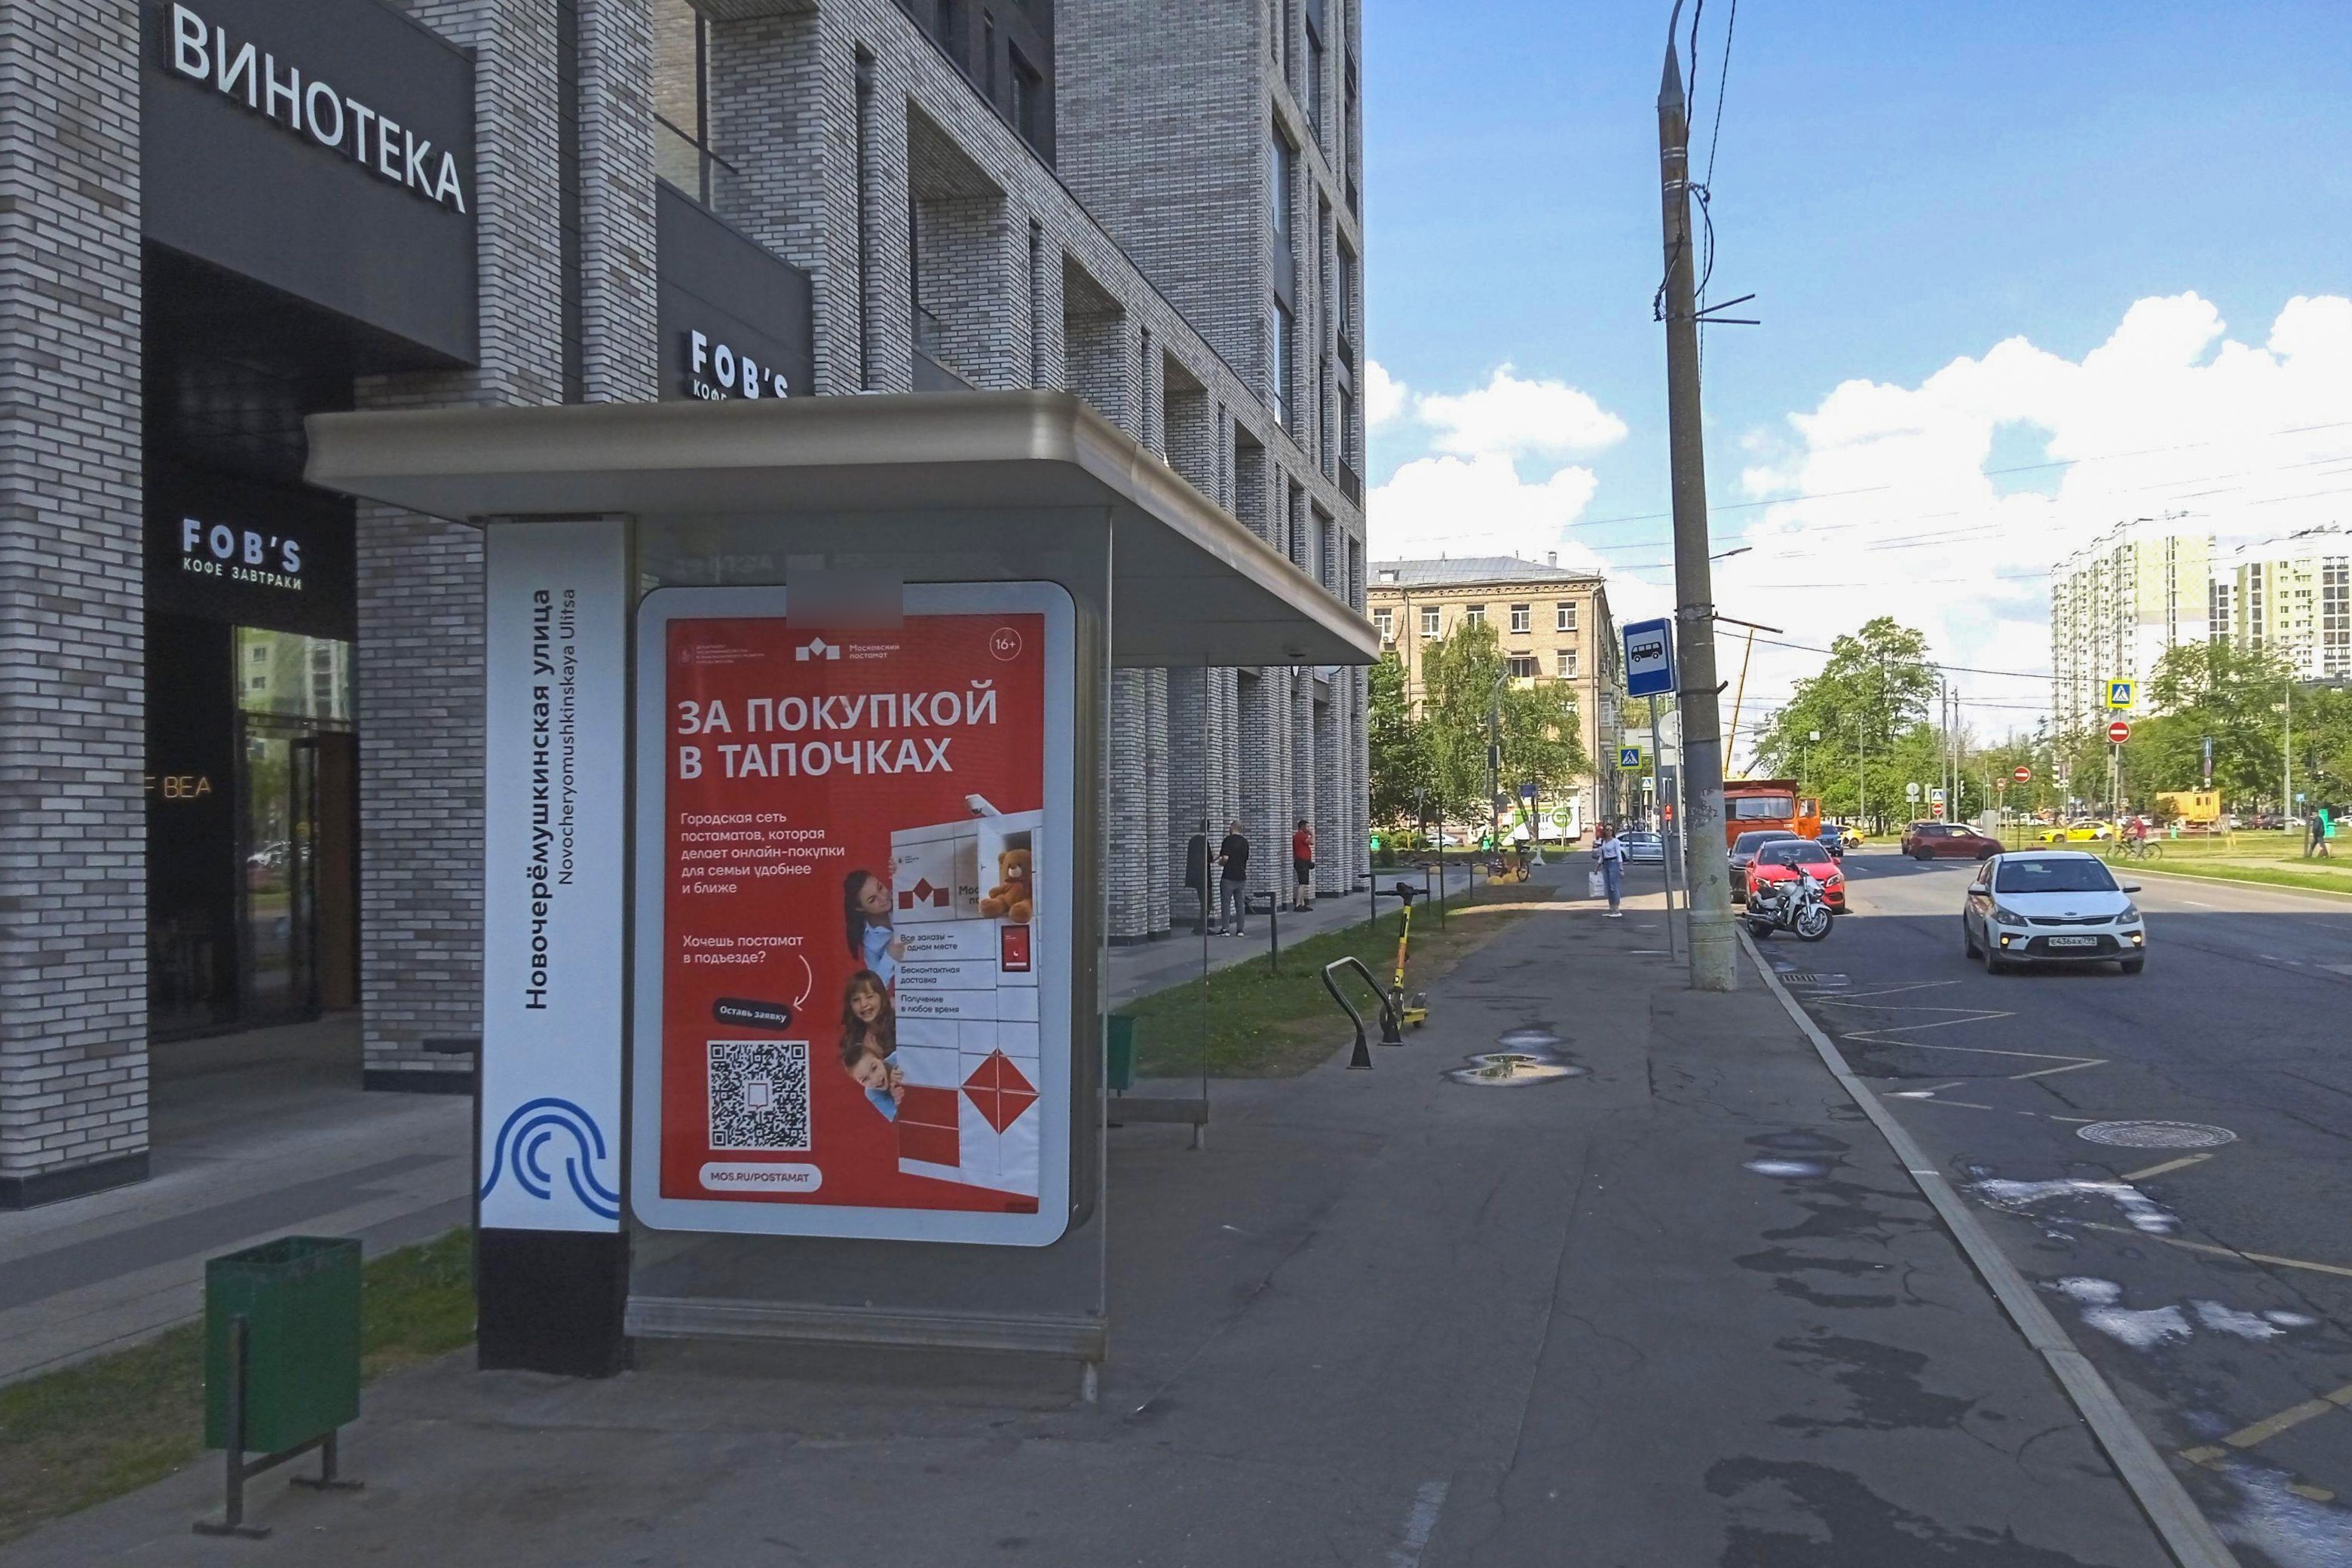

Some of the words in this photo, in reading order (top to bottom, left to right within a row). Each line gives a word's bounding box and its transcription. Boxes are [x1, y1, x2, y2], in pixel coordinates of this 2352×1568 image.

[173, 2, 466, 215] ВИНОТЕКА
[691, 329, 789, 400] FOB'S
[183, 518, 301, 573] FOB'S
[183, 558, 223, 577] КОФЕ
[231, 566, 302, 590] ЗАВТРАКИ
[559, 589, 575, 639] Ulitsa
[533, 589, 555, 675] улица
[995, 638, 1016, 650] 16+
[678, 700, 731, 735] ЗА
[747, 678, 997, 732] ПОКУПКОЙ
[558, 645, 578, 885] Novocheryomushkinskaya
[679, 746, 703, 779] В
[718, 737, 953, 778] ТАПОЧКАХ
[681, 813, 752, 826] Городская
[756, 812, 787, 822] сеть
[681, 830, 765, 842] постаматов,
[768, 830, 825, 841] которая
[525, 685, 554, 1009] Новочерёмушкинская
[681, 848, 728, 861] делает
[730, 846, 845, 859] онлайн-покупки
[681, 866, 704, 877] для
[708, 865, 750, 876] семьи
[754, 863, 812, 877] удобнее
[681, 884, 691, 893] и
[694, 881, 737, 894] ближе
[682, 935, 734, 948] Хочешь
[737, 936, 804, 946] постамат
[683, 954, 691, 963] в
[694, 951, 766, 964] подъезде?
[900, 966, 960, 974] Бесконтактная
[900, 994, 944, 1003] Получение
[720, 1006, 753, 1017] Оставь
[755, 1011, 787, 1023] заявку
[908, 1004, 933, 1013] любое
[710, 1171, 810, 1183] MOS.RU/POSTAMAT
